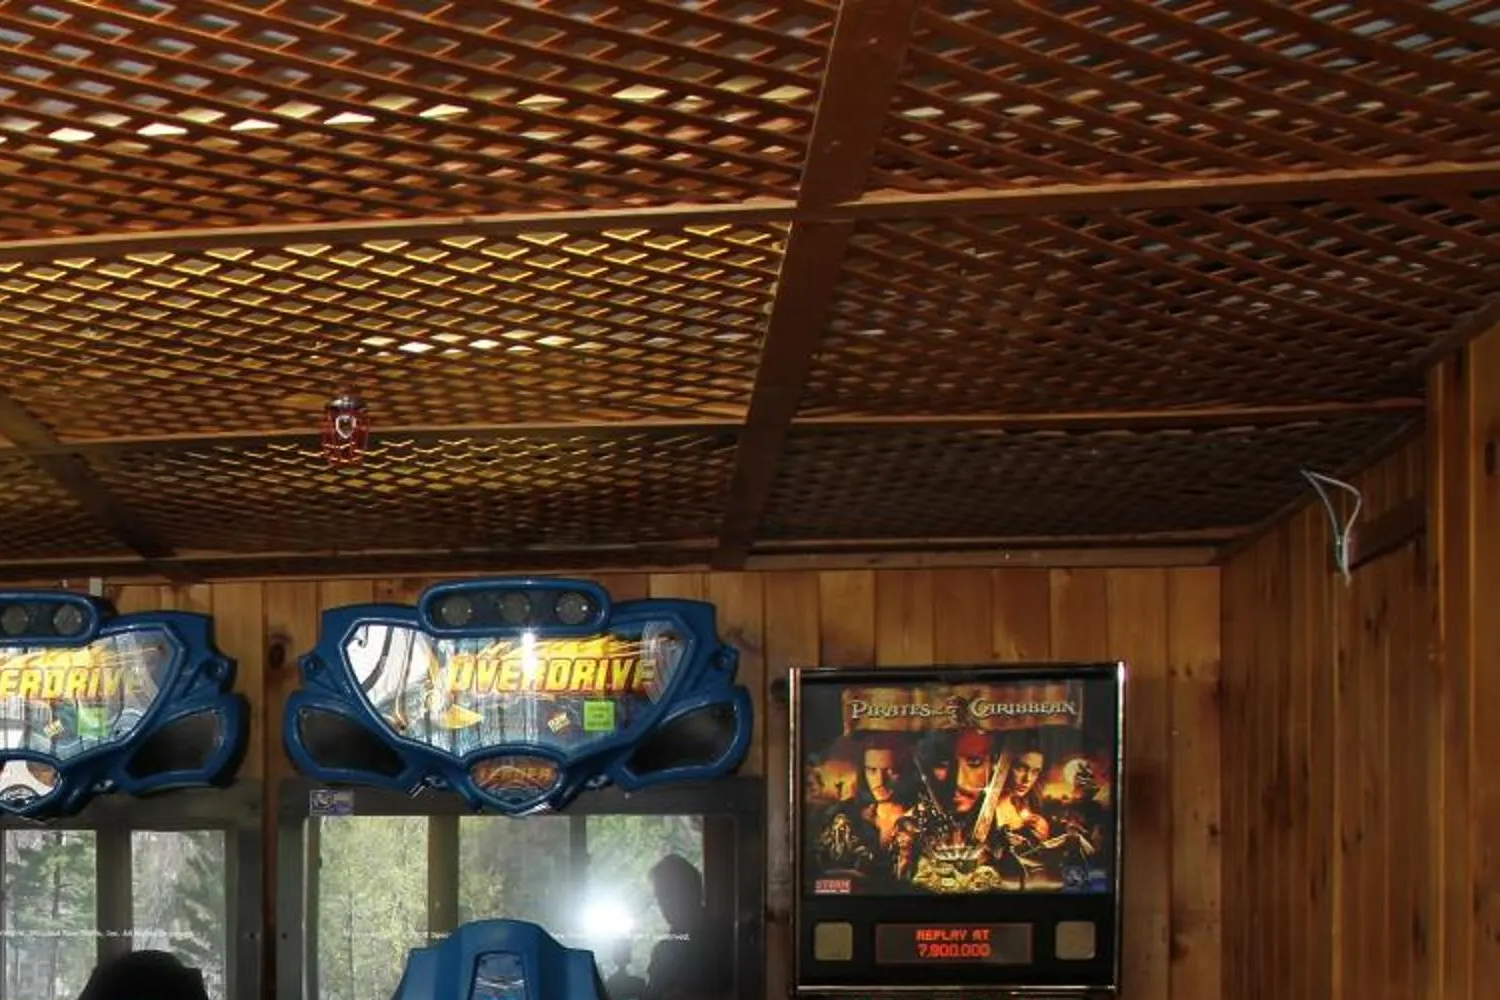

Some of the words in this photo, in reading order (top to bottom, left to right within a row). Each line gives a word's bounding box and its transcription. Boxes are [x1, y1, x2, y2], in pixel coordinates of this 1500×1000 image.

[451, 656, 657, 693] OVERDRIVE
[851, 699, 932, 719] PIRATES
[969, 697, 1078, 720] CARIBBEAN
[915, 929, 968, 941] REPLAY
[972, 929, 990, 940] AT
